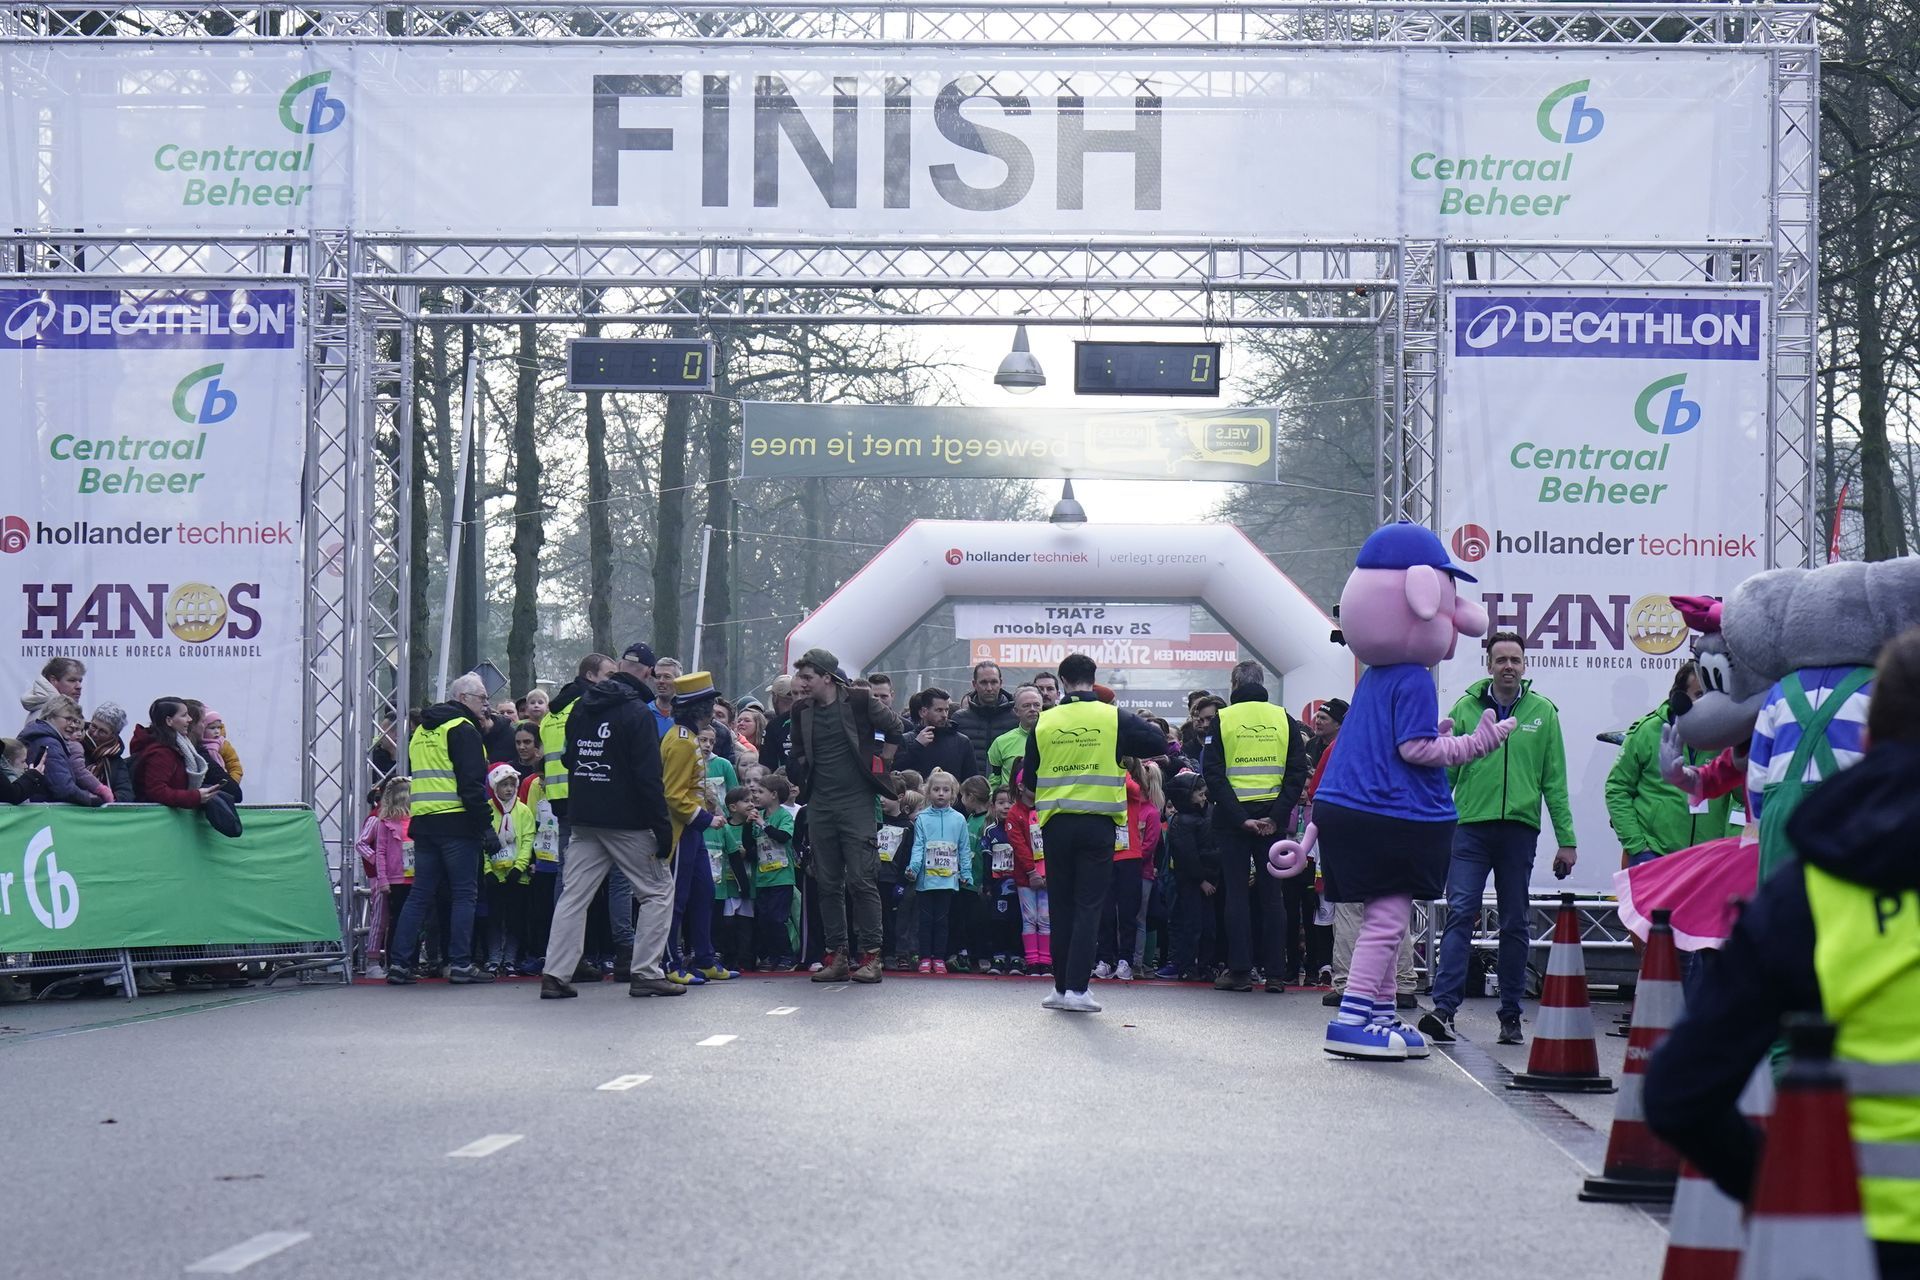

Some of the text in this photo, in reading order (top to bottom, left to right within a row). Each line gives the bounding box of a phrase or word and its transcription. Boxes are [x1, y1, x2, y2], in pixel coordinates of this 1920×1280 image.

[592, 73, 1163, 212] FINISH
[154, 144, 315, 173] Centraal
[1410, 152, 1574, 182] Centraal
[182, 178, 313, 207] Beheer
[1439, 186, 1572, 217] Beheer
[63, 303, 286, 335] DECATHLON
[1523, 310, 1751, 347] DECATHLON
[49, 432, 207, 461] Centraal
[1509, 441, 1671, 471] Centraal
[78, 467, 206, 494] Beheer
[1538, 475, 1668, 505] Beheer
[36, 521, 293, 545] hollander techniek
[1496, 530, 1757, 558] hollander techniek
[965, 551, 1207, 565] hollander techniek verlegt grenzen
[21, 582, 262, 643] HANOS
[1481, 592, 1724, 656] HANO
[21, 645, 262, 658] INTERNATIONALE HORECA GROOTHANDEL
[1481, 655, 1686, 670] IATIONALE HORECA GROOTH
[1052, 763, 1100, 773] ORGANISATIE
[1234, 755, 1277, 763] ORGANISATIE
